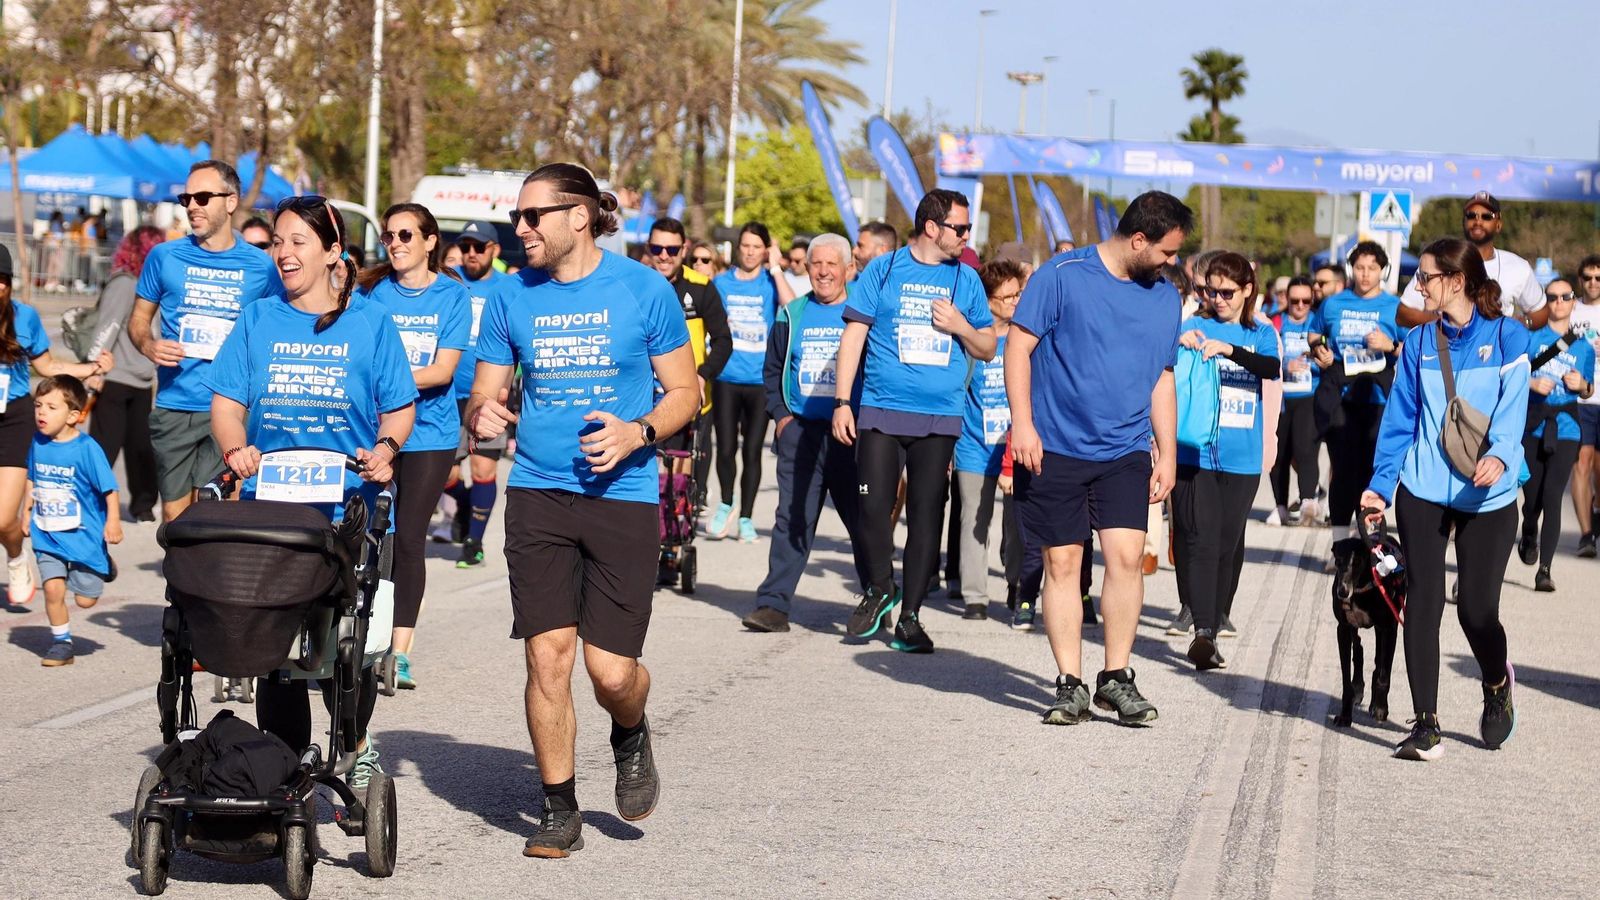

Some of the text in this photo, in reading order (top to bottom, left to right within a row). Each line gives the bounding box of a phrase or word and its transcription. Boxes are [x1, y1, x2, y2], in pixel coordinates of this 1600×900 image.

[1341, 161, 1434, 186] mayoral
[187, 266, 245, 281] mayoral
[902, 283, 950, 296] mayoral
[534, 309, 609, 329] mayoral
[803, 327, 844, 337] mayora
[532, 335, 606, 348] RUNNING
[273, 342, 349, 358] mayoral
[539, 346, 601, 358] MAKES
[268, 363, 344, 377] RUNNING
[274, 373, 336, 386] MAKES
[1221, 399, 1245, 413] 031
[276, 466, 327, 483] 1214
